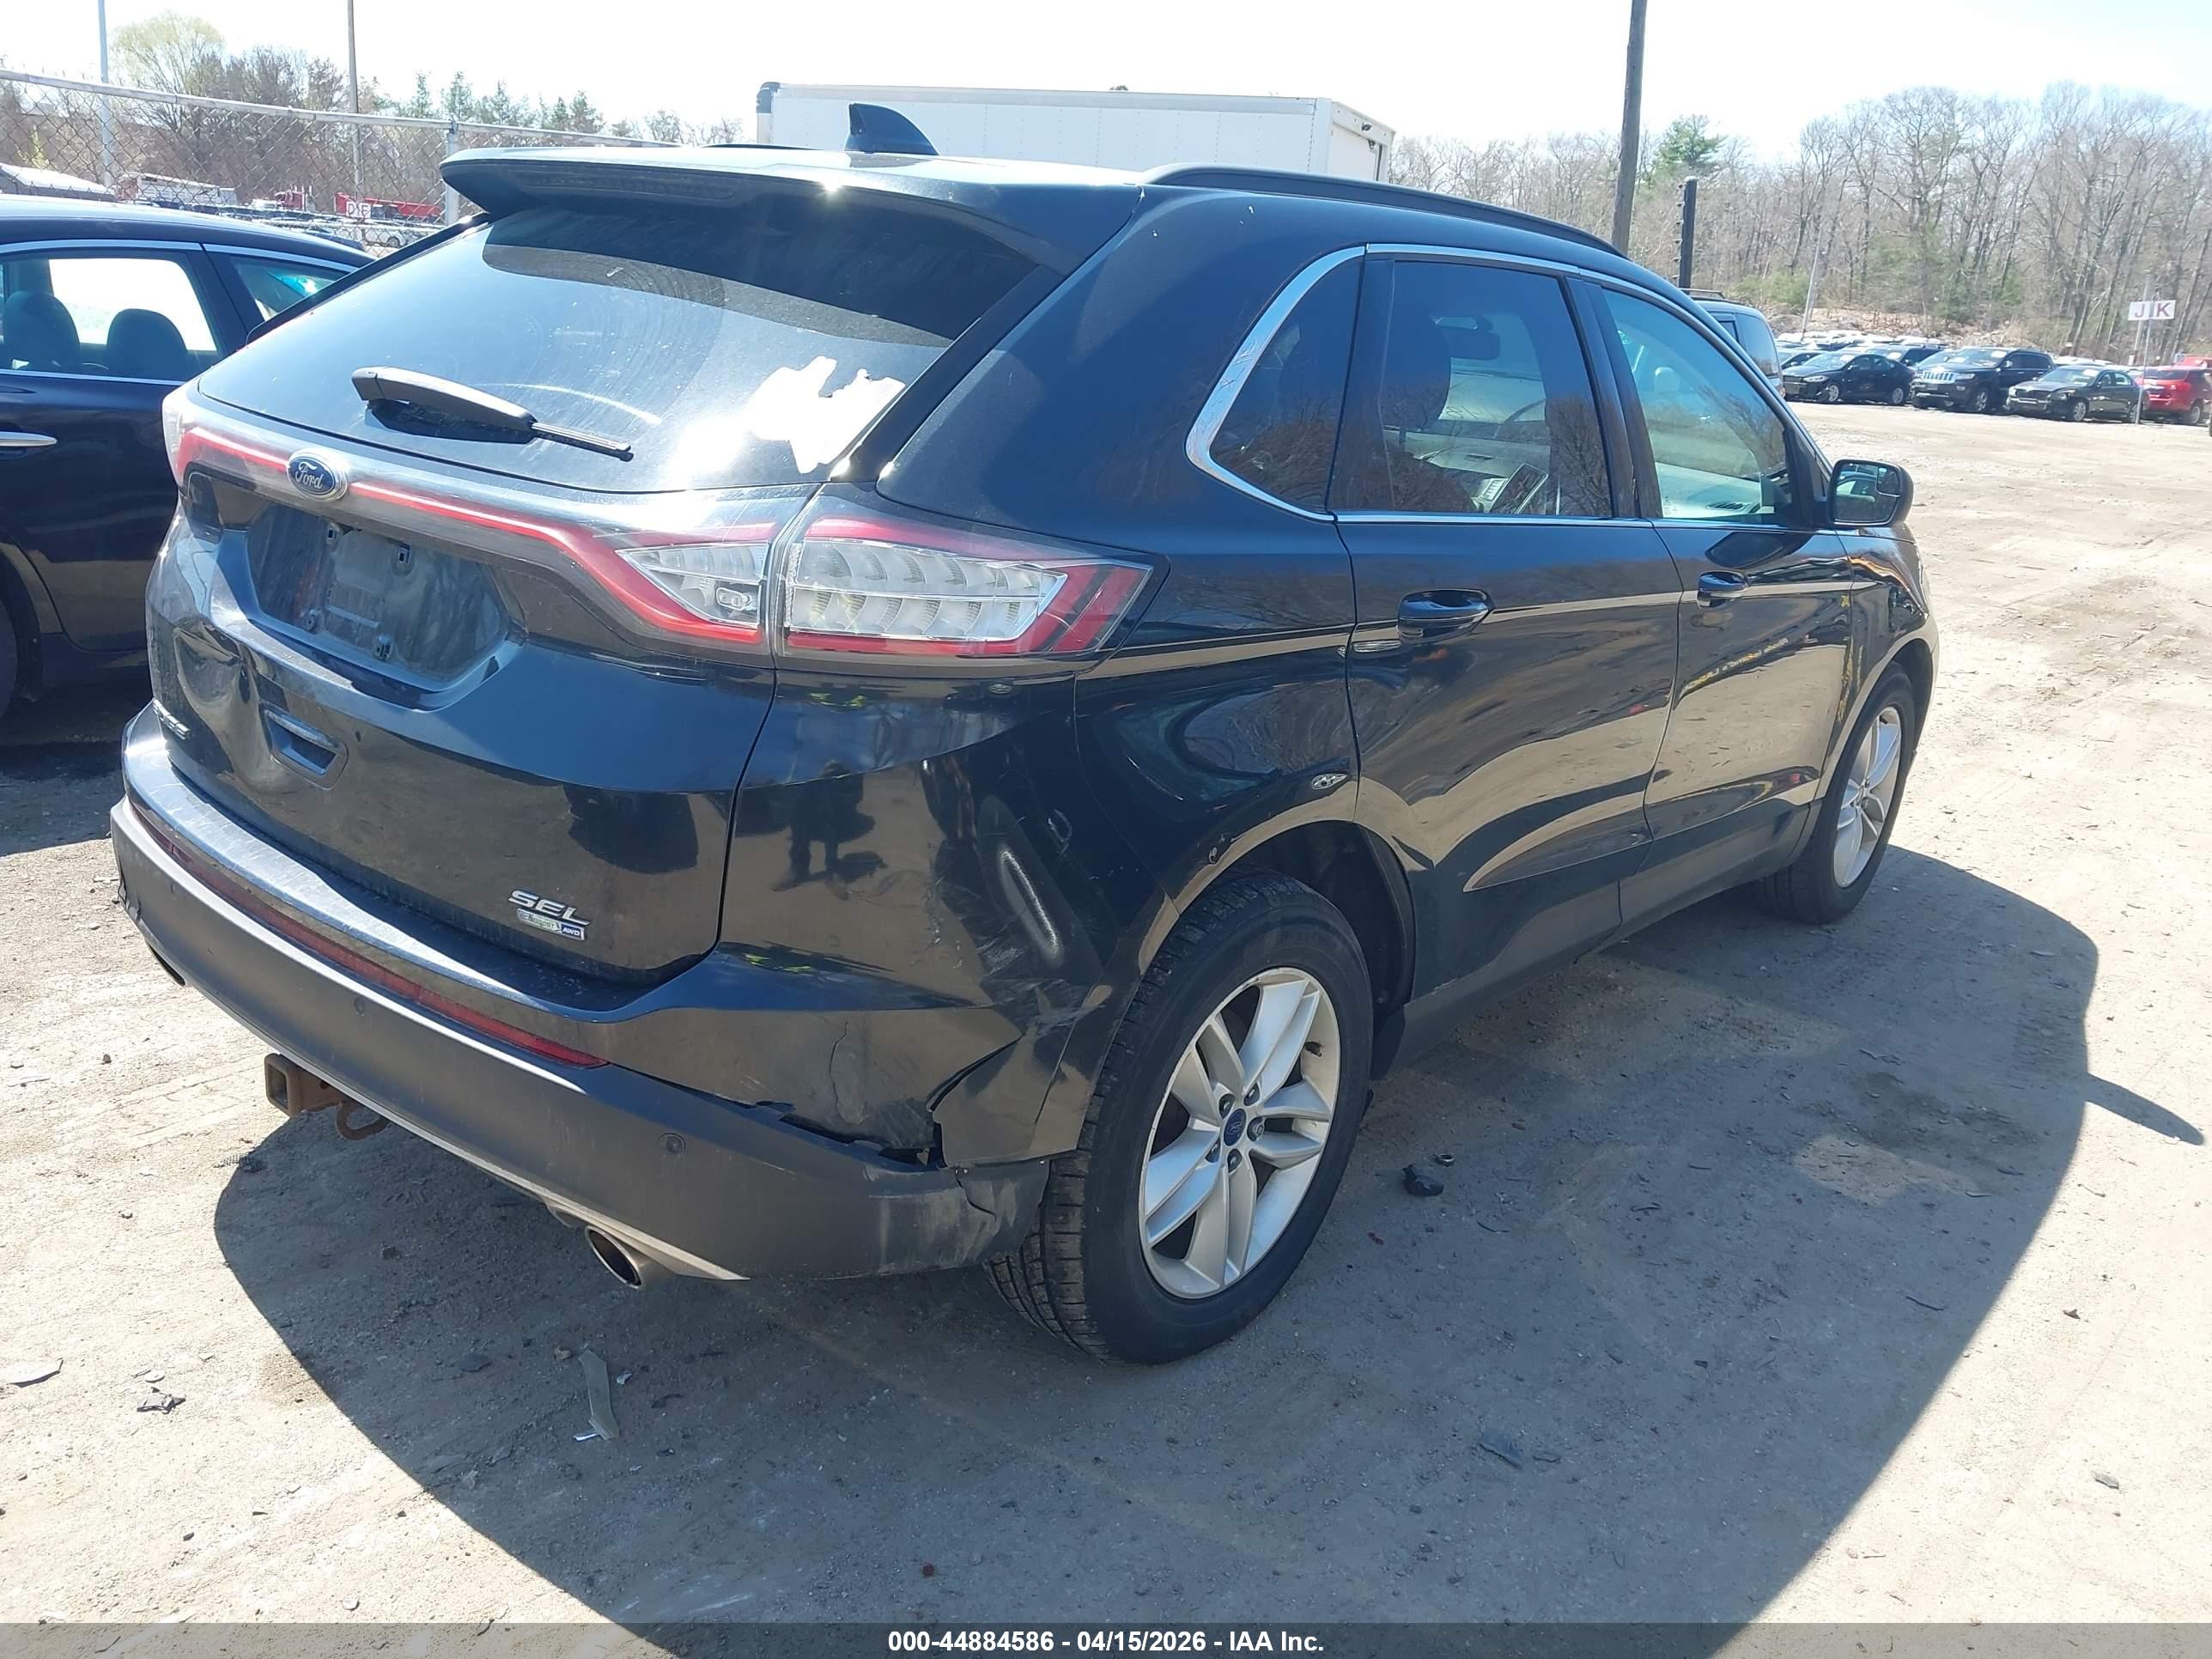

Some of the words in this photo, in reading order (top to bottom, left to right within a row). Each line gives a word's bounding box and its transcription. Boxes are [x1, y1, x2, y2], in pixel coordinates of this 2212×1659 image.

[295, 460, 325, 489] Ford
[508, 890, 591, 927] SEL
[562, 927, 581, 937] AWD
